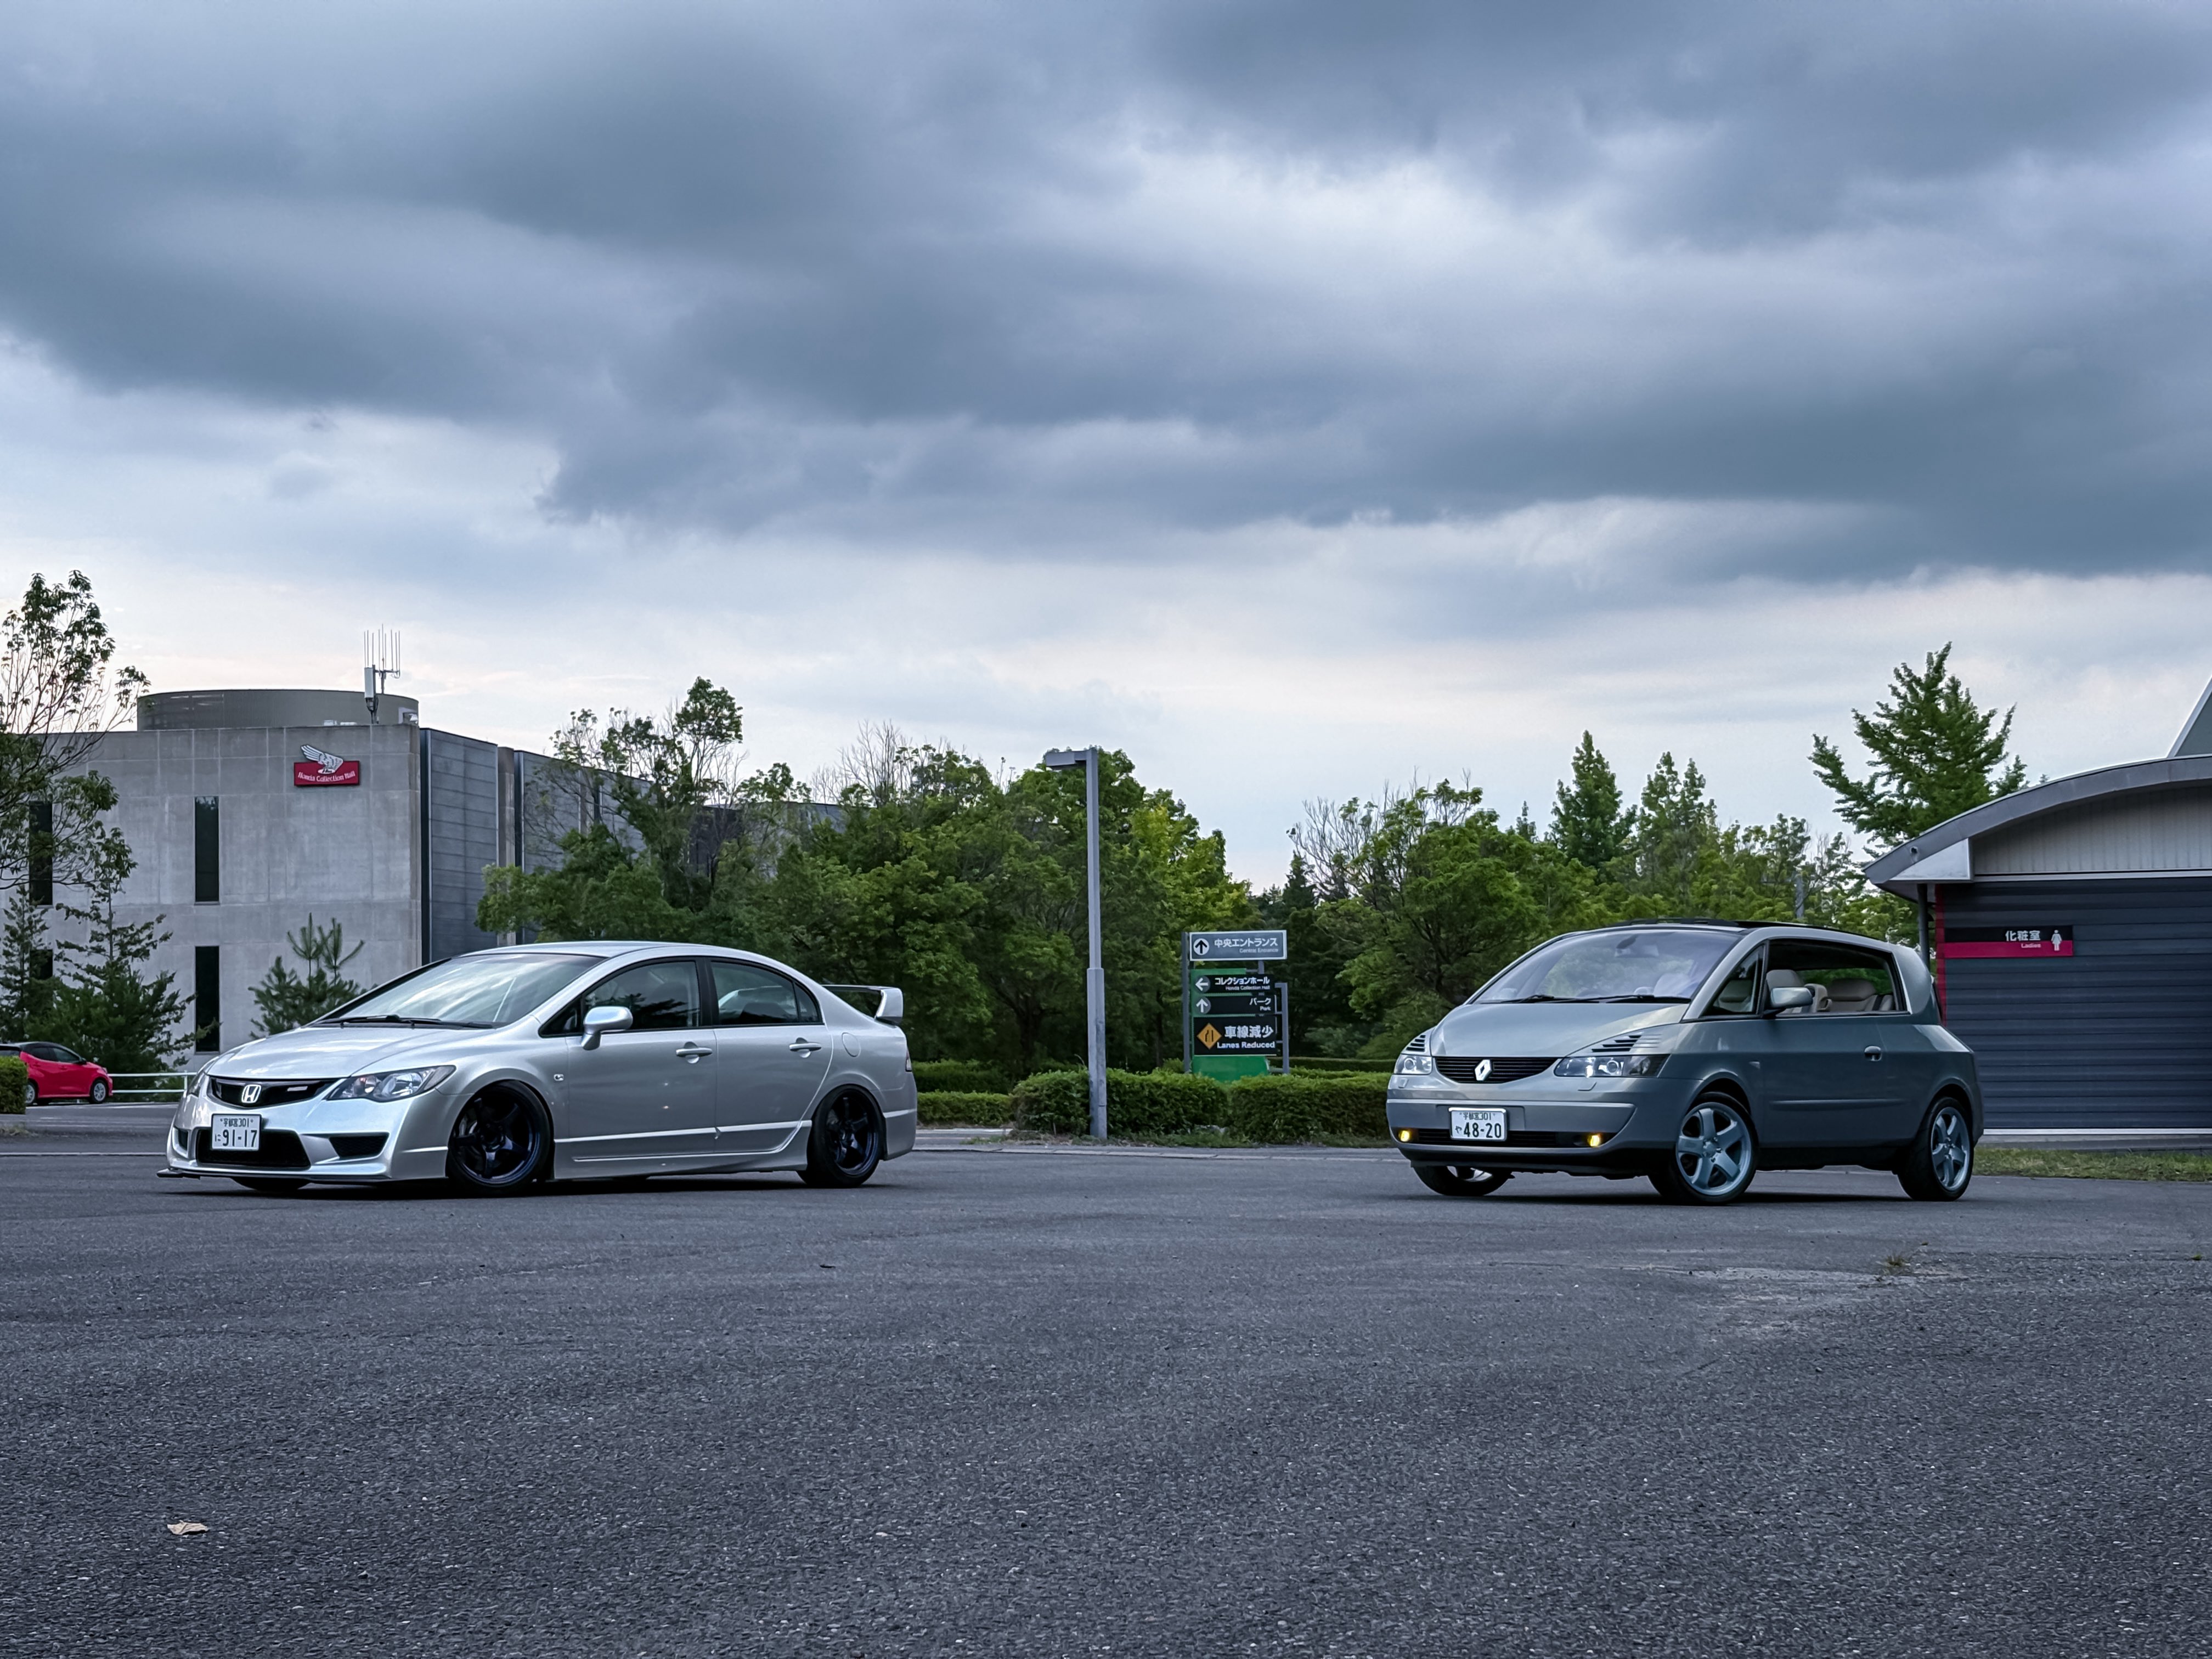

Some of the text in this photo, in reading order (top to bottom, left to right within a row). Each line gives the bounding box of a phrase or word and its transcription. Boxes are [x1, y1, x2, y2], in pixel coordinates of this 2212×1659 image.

[2005, 930, 2041, 941] 化粧室
[1214, 938, 1278, 947] 中央エントランス
[1215, 977, 1270, 985] コレクションホール
[1224, 1025, 1274, 1039] 車線減少
[1463, 1122, 1502, 1138] 48-20
[222, 1129, 257, 1147] 91-17
